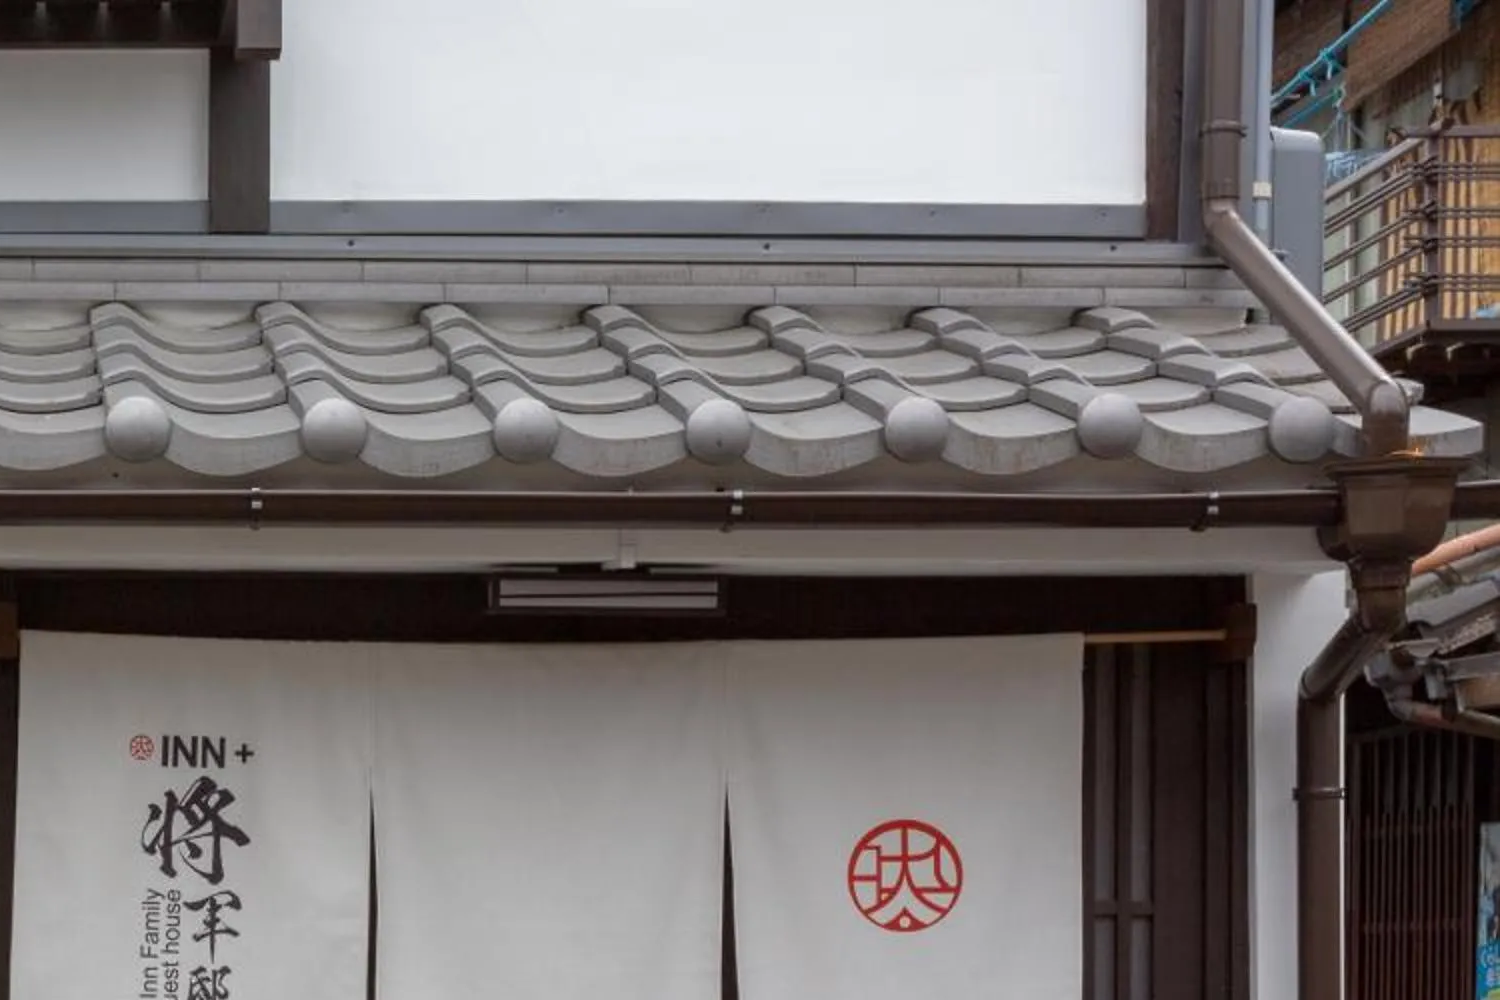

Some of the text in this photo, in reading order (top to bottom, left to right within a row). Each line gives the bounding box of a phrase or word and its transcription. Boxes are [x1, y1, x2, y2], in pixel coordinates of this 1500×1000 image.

[139, 888, 165, 999] Inn Family
[161, 889, 181, 955] house
